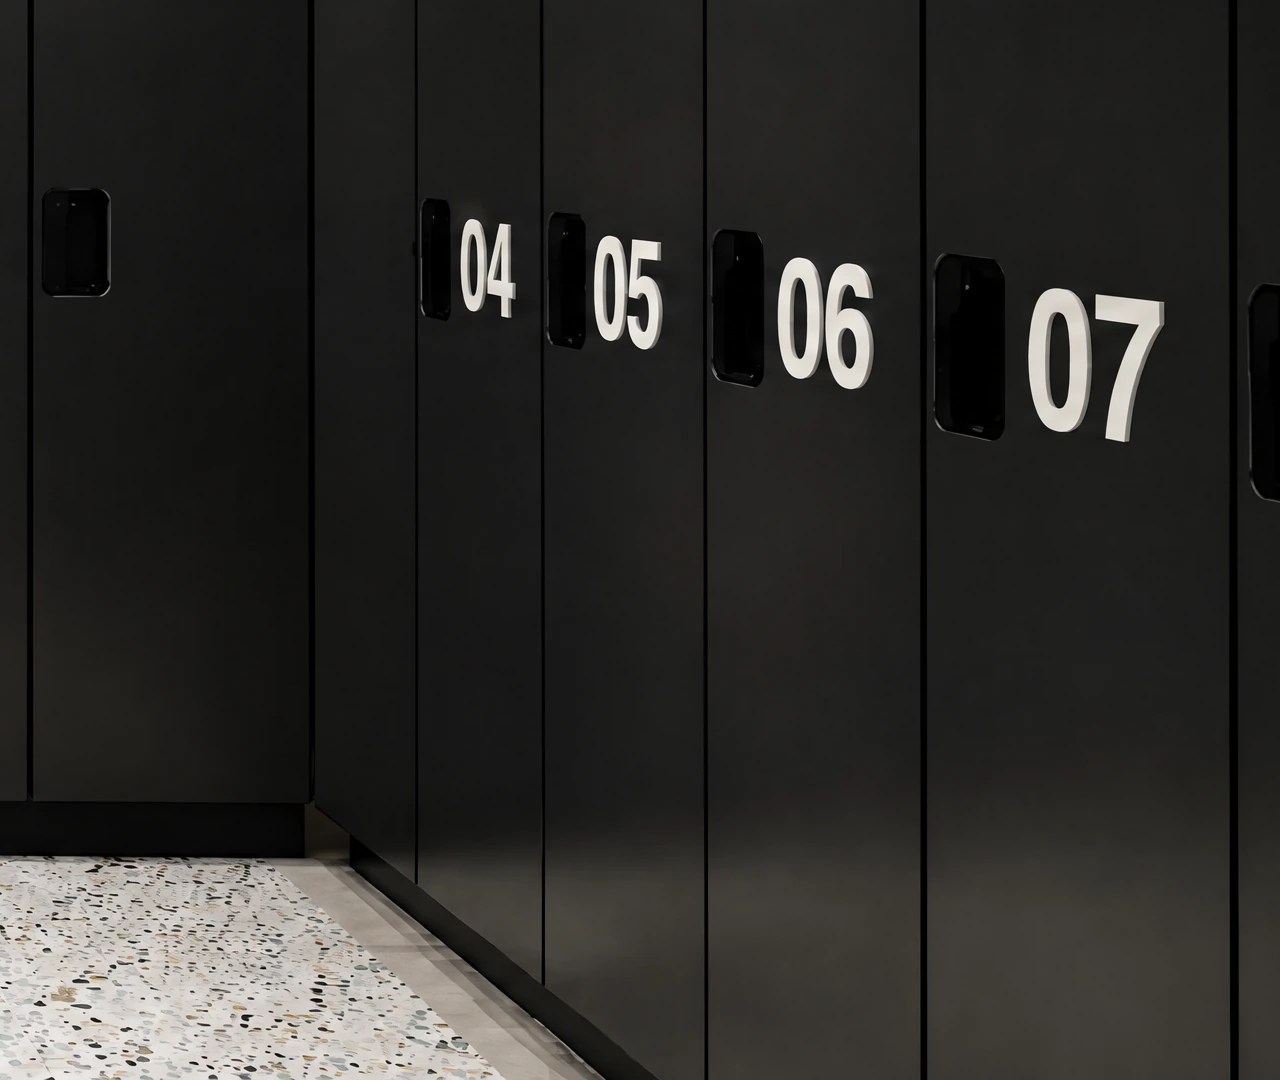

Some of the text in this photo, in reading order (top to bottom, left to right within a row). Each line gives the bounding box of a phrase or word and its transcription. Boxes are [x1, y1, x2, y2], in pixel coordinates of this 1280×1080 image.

[459, 217, 517, 320] 04
[592, 234, 664, 351] 05
[776, 256, 875, 391] 06
[1026, 287, 1166, 443] 07
